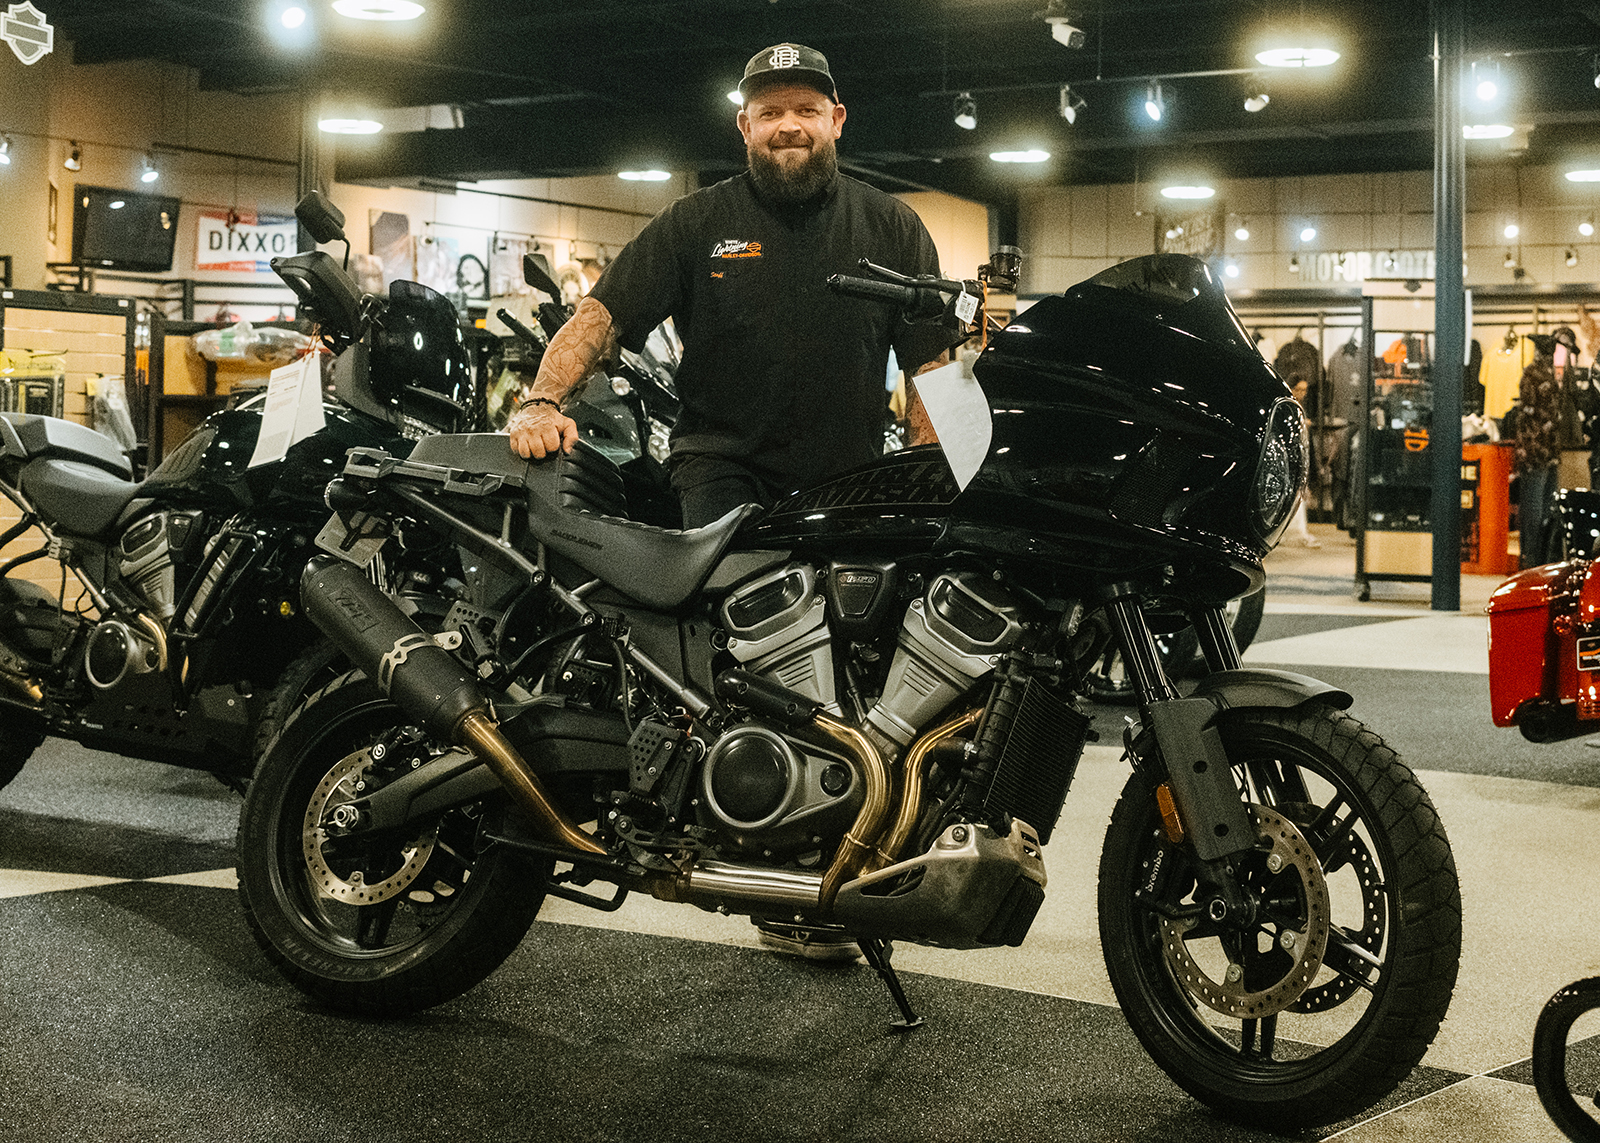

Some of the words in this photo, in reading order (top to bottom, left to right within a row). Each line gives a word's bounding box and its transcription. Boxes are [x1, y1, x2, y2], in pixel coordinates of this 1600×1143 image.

[710, 240, 748, 258] Lightning
[1301, 251, 1371, 282] MOTOR
[1145, 850, 1164, 892] brembo
